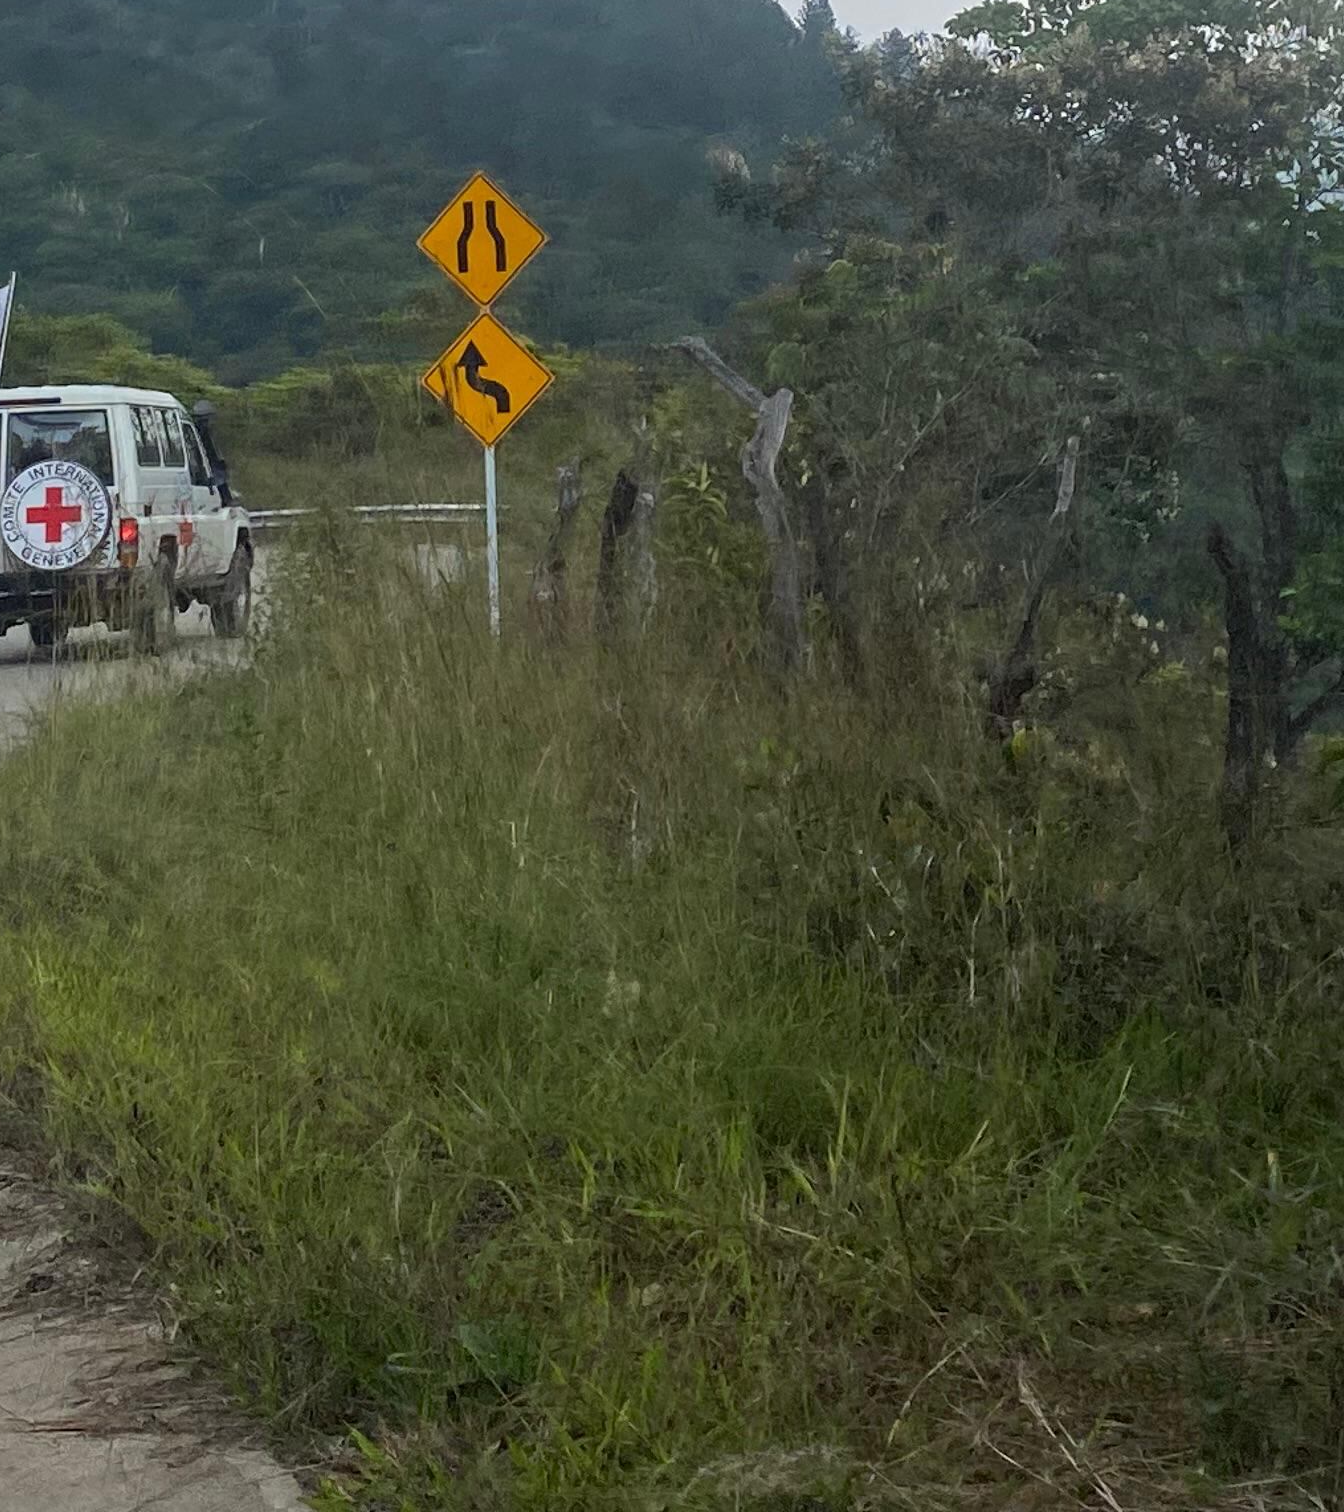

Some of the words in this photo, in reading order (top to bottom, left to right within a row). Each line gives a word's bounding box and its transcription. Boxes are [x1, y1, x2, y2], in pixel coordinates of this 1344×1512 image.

[2, 481, 25, 543] COMITE
[27, 463, 106, 541] INTERNATIONAL
[21, 545, 86, 567] GENEVE
